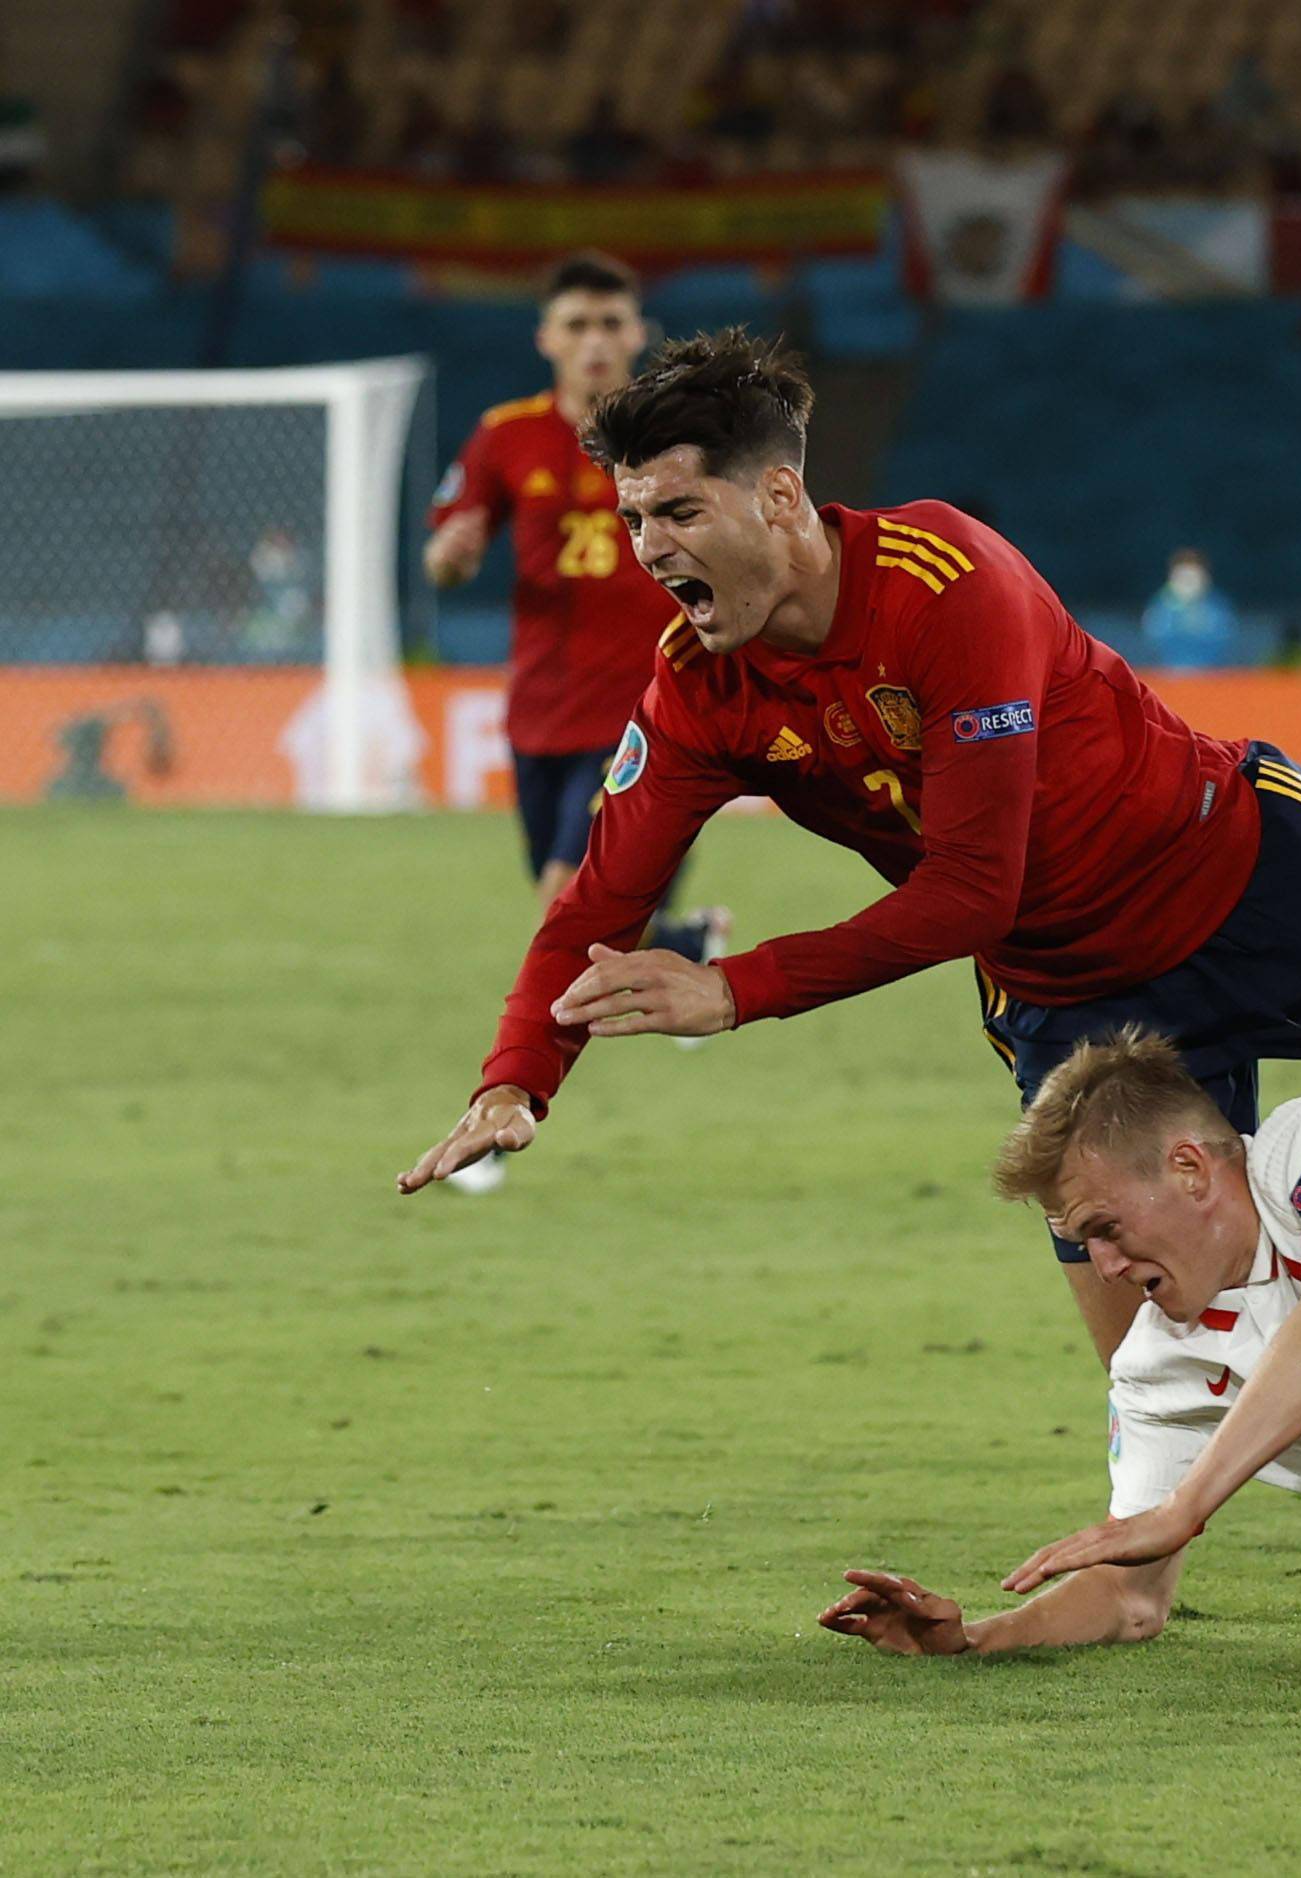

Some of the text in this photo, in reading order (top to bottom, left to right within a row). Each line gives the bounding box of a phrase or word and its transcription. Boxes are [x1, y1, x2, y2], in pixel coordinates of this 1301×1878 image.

[558, 510, 619, 577] 26
[981, 708, 1032, 731] RESPECT
[767, 743, 813, 762] adidas
